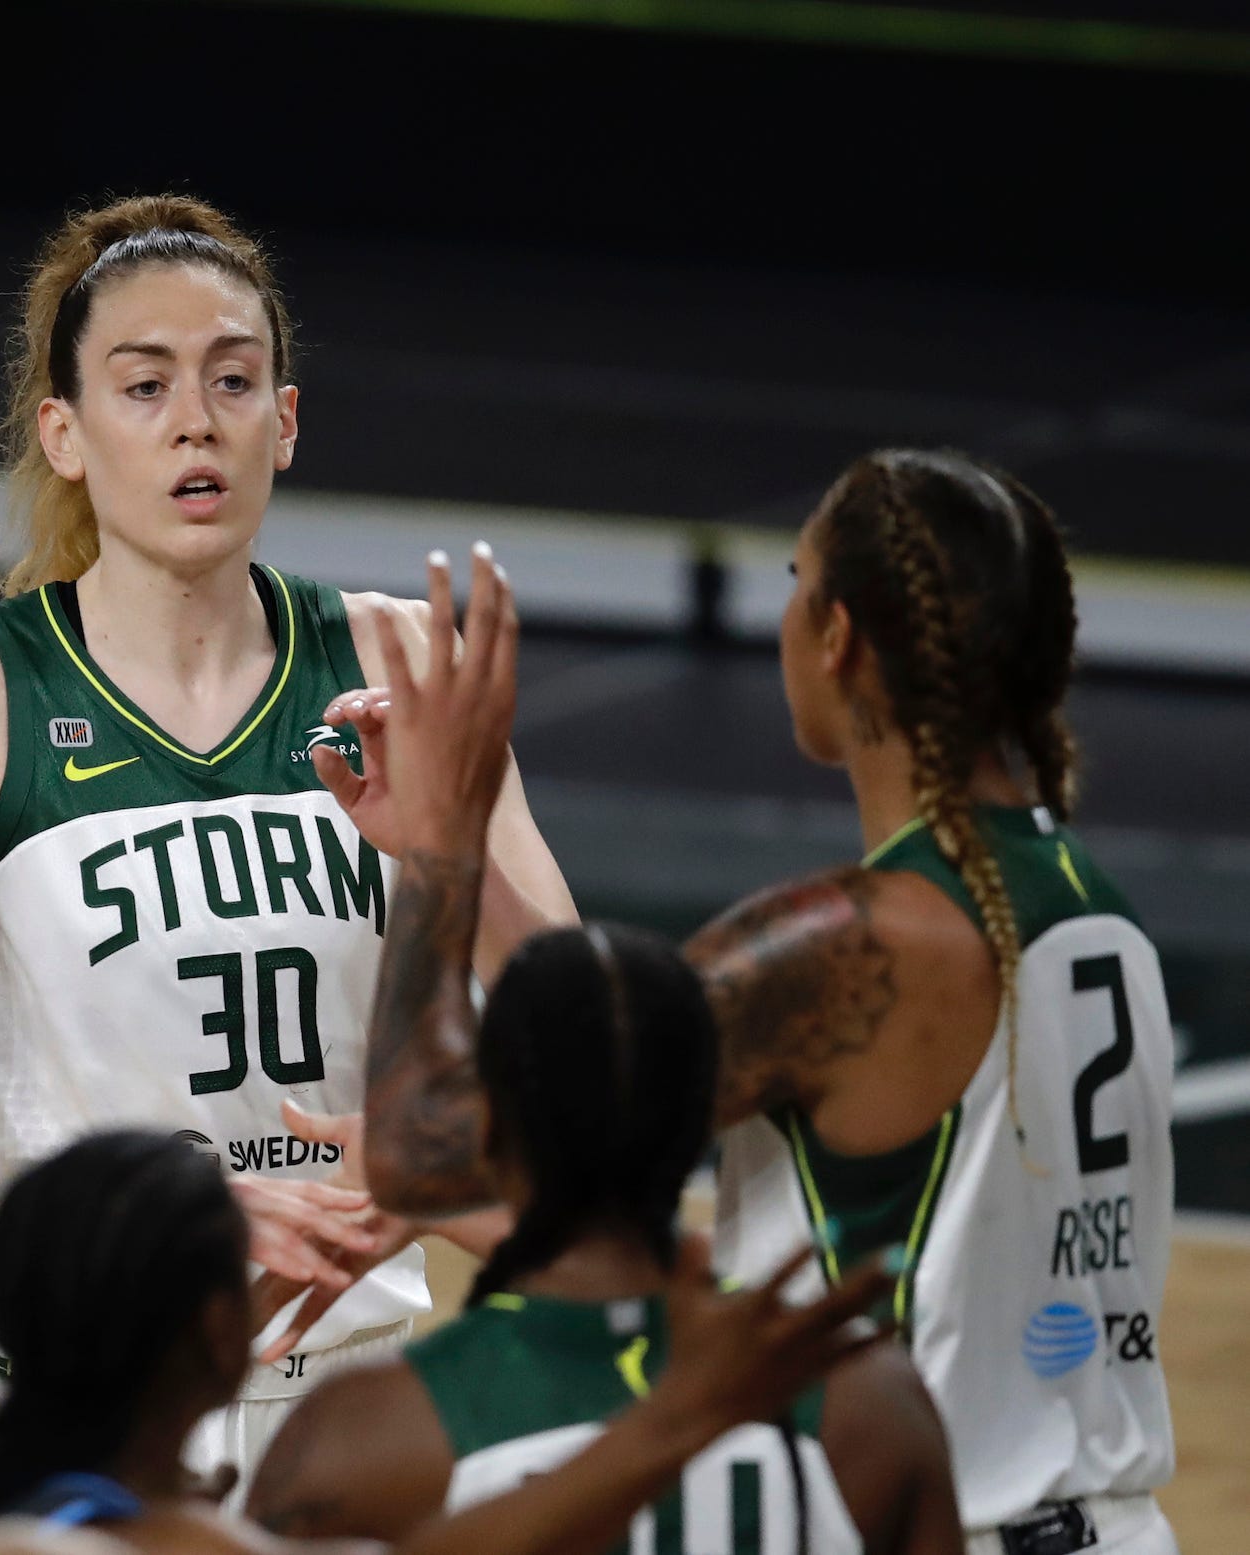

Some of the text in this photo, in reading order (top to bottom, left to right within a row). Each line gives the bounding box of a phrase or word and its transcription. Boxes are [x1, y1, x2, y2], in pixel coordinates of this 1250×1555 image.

[290, 742, 360, 762] SYRA
[79, 810, 386, 967] STORM
[177, 947, 325, 1096] 30
[1072, 954, 1134, 1174] 2
[229, 1136, 345, 1172] SWEDIS
